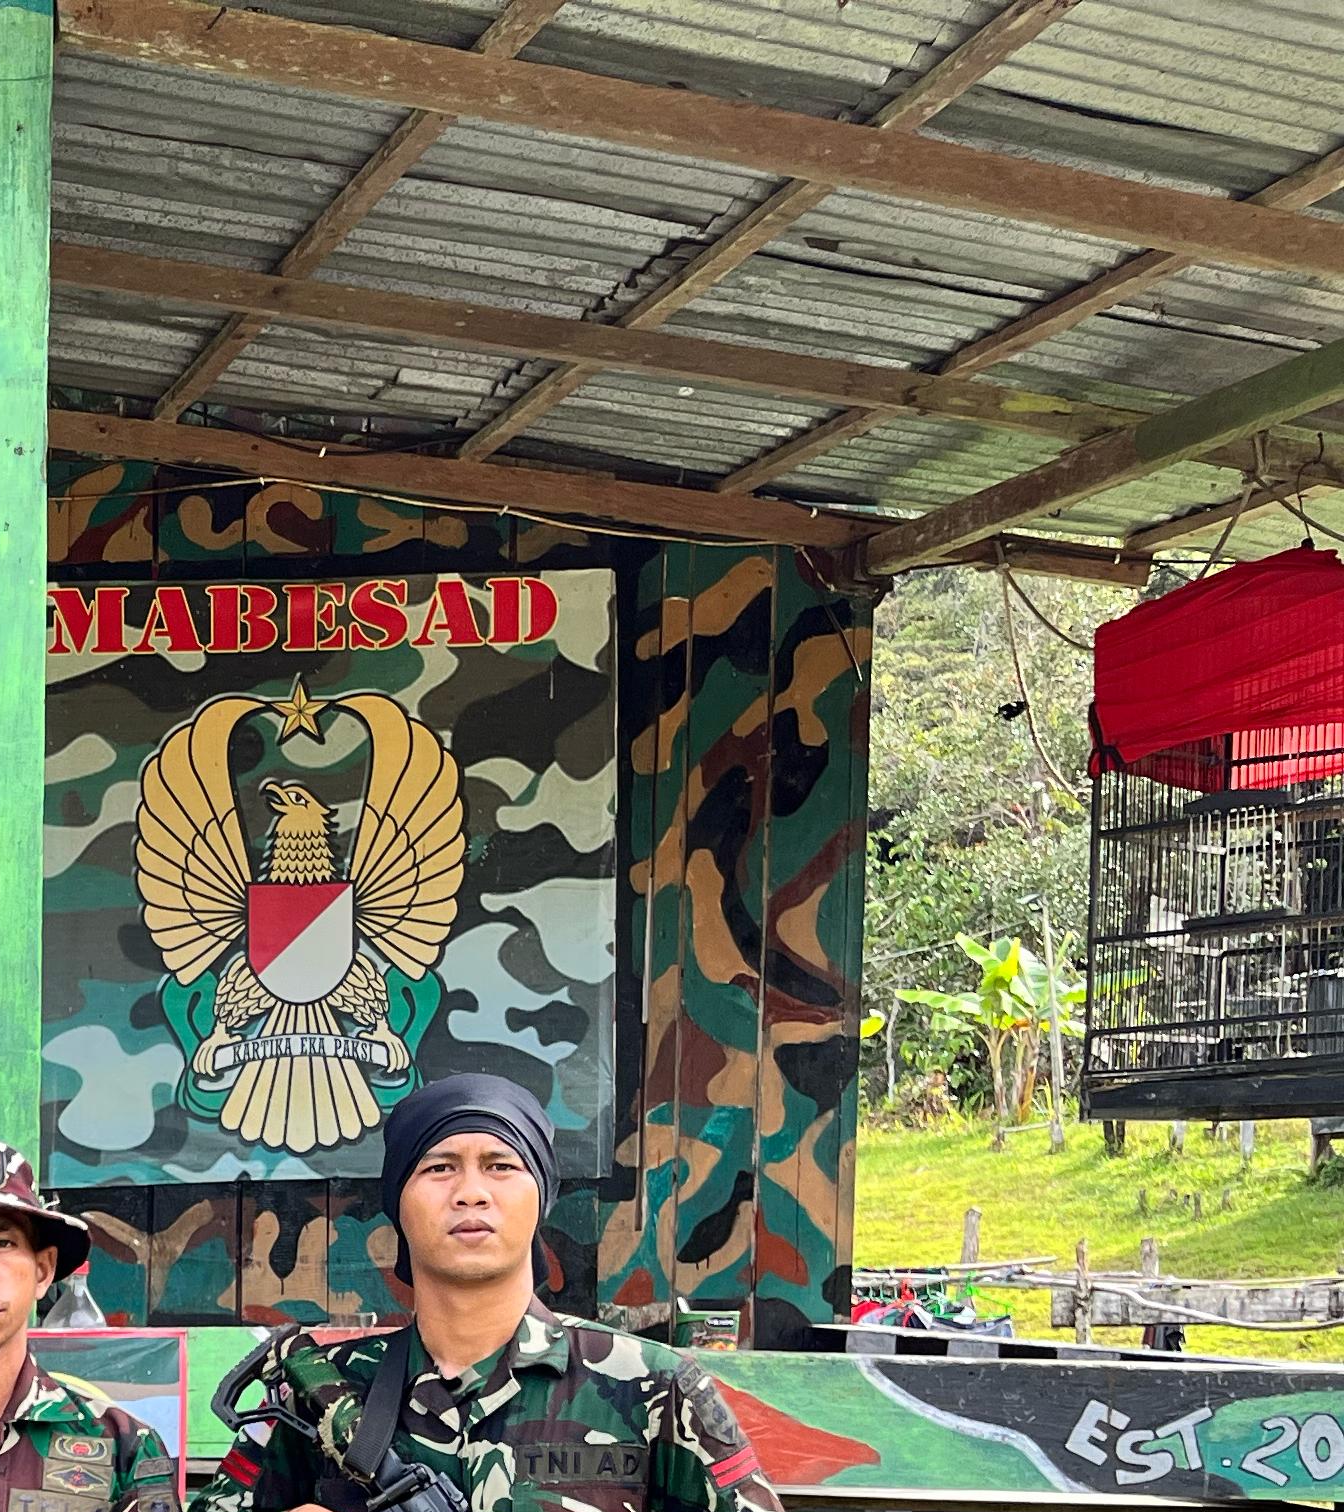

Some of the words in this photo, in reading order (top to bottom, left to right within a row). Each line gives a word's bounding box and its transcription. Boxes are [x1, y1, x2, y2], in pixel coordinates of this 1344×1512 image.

[232, 1037, 292, 1065] KARTIKA
[299, 1036, 326, 1055] EKA
[333, 1037, 375, 1063] PAKSI
[524, 1448, 581, 1477] TNI
[596, 1450, 641, 1477] AD
